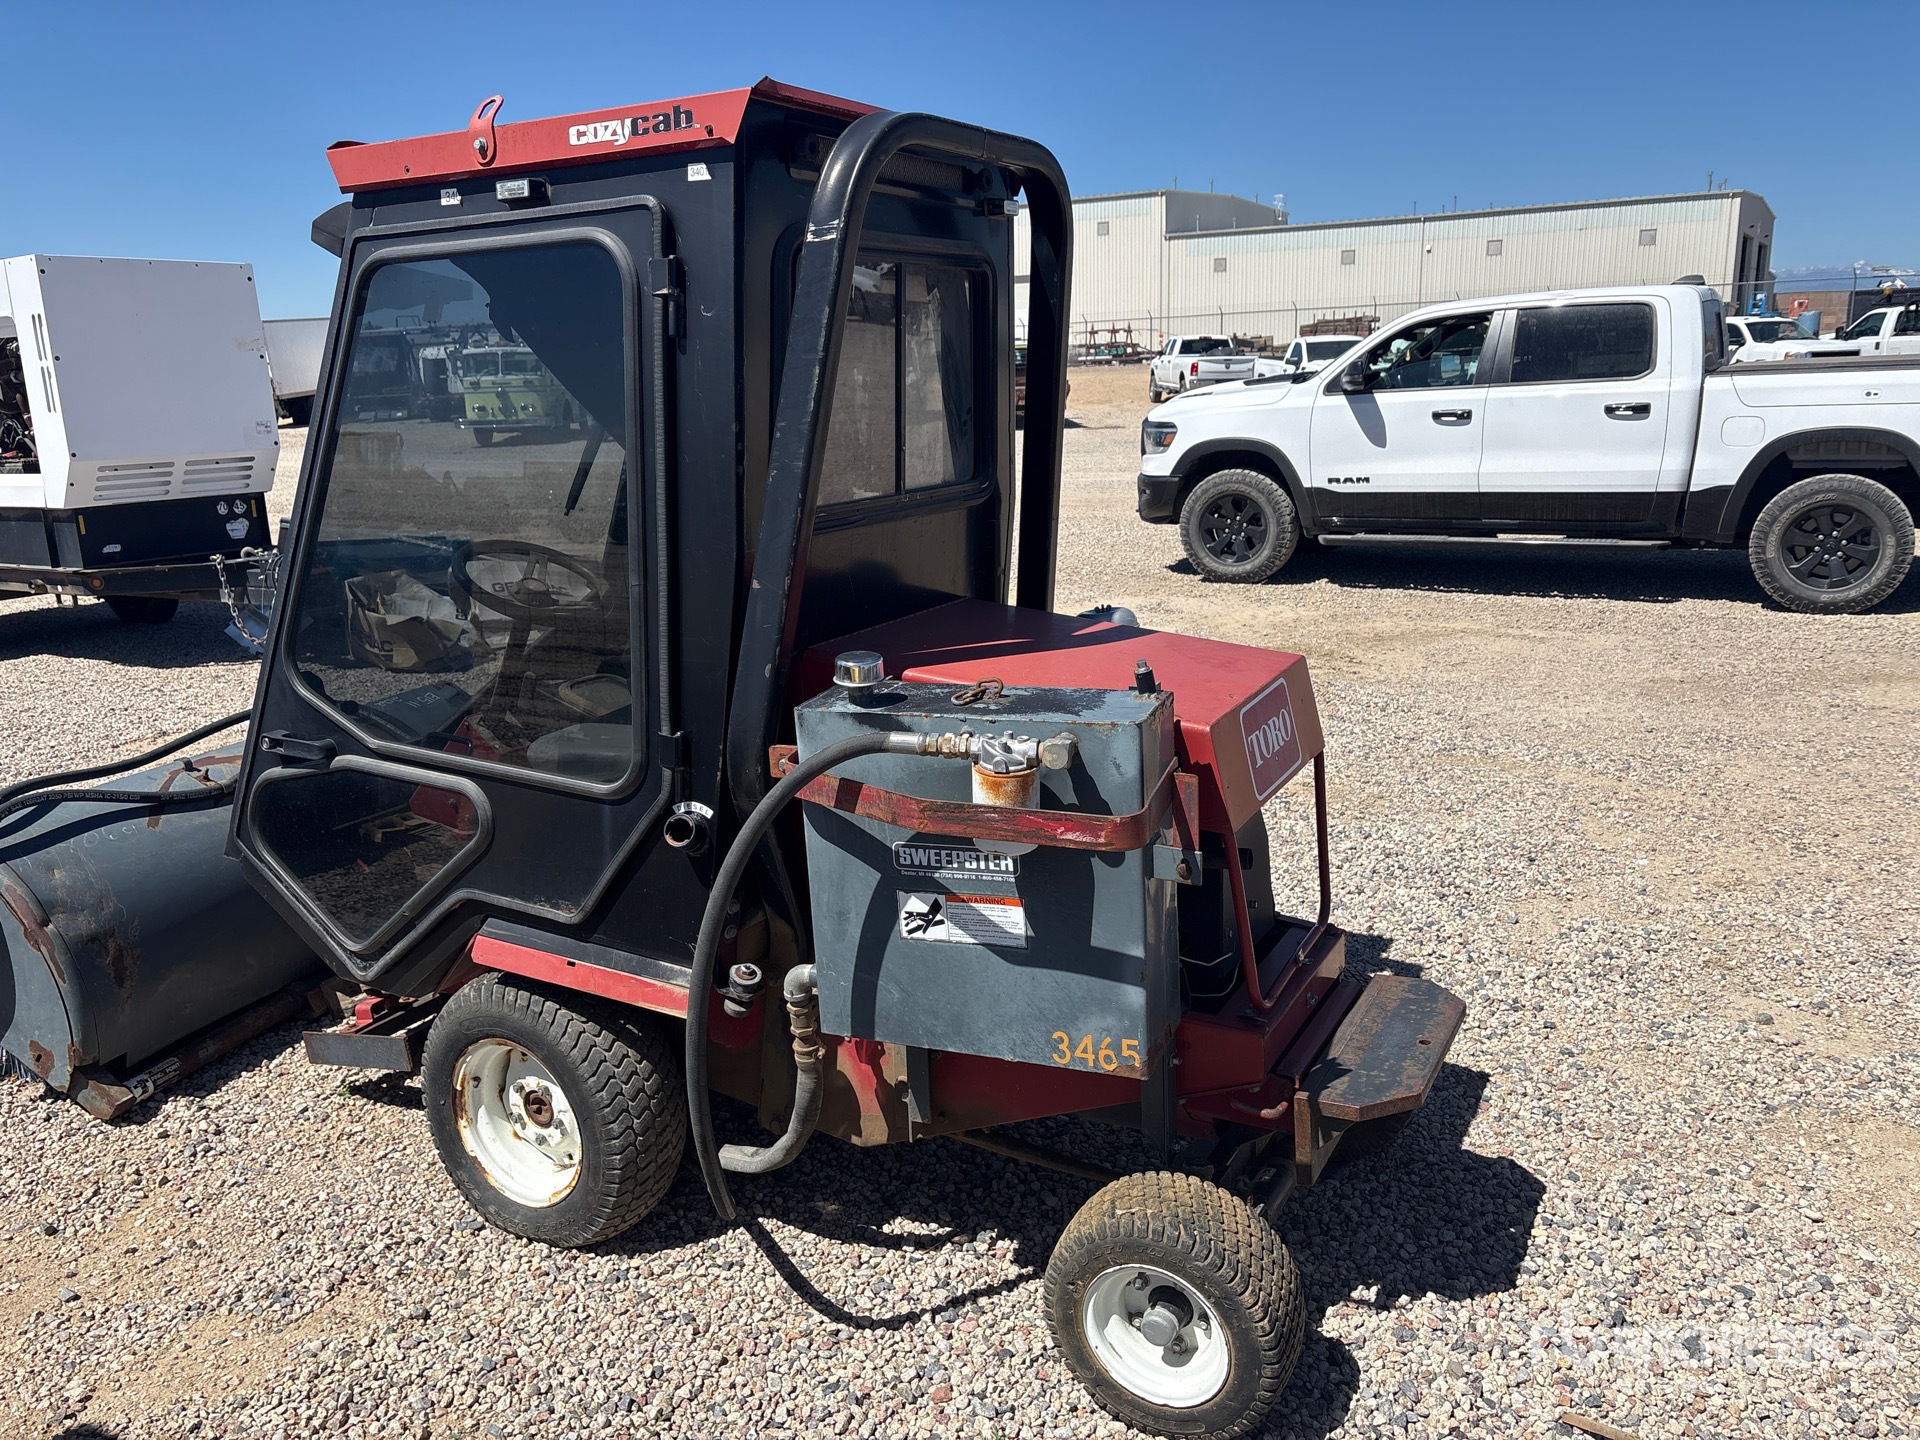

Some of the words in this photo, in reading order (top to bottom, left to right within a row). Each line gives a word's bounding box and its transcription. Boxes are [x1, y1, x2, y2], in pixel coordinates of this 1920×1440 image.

[1820, 534, 1896, 600] GOODYEAR
[1248, 708, 1291, 768] TORO
[676, 803, 709, 816] DIESEL
[899, 847, 1014, 872] SWEEPSTER
[966, 896, 1006, 905] WARNING
[1052, 1031, 1141, 1072] 3465
[1070, 1243, 1124, 1276] MULTI
